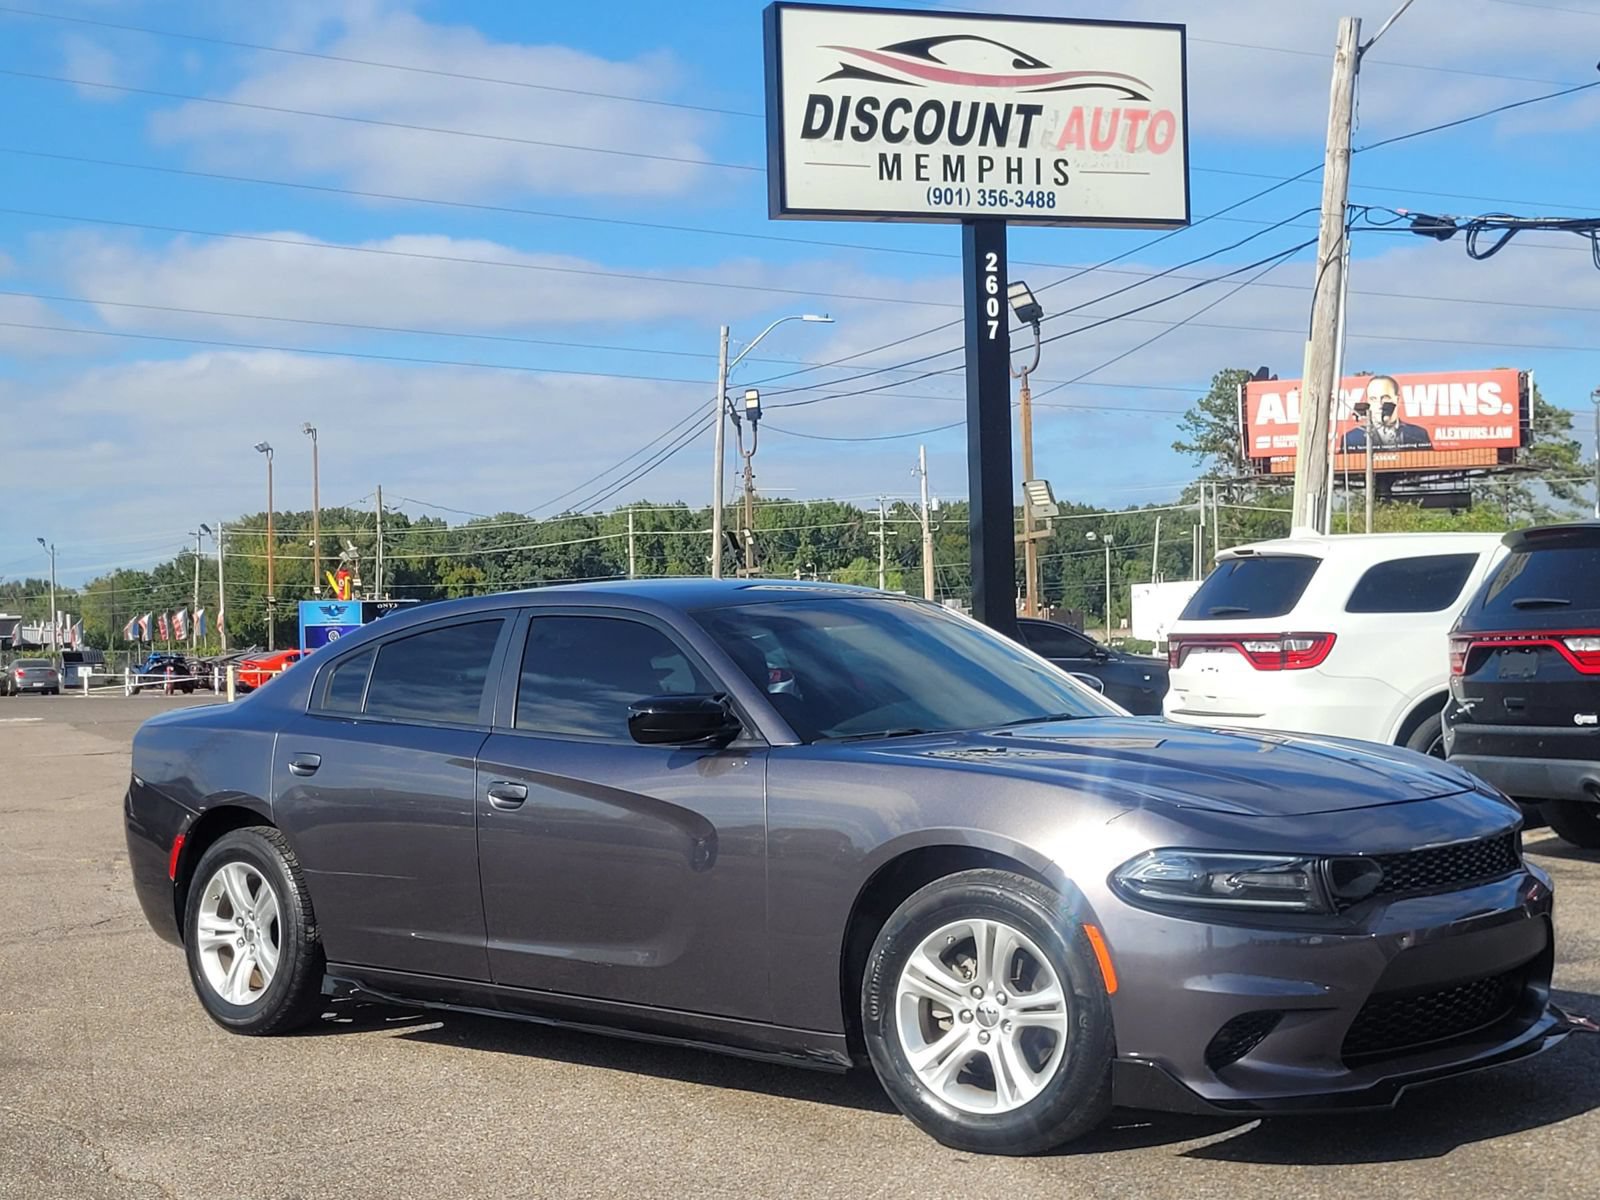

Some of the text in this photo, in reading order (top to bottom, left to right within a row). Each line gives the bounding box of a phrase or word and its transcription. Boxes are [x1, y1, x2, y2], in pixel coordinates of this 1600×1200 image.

[800, 94, 1176, 155] DISCOUNT AUTO
[878, 152, 1070, 186] MEMPHIS
[926, 187, 1056, 210] (901) 356-3488
[984, 252, 999, 340] 2607
[1402, 382, 1513, 416] WINS.
